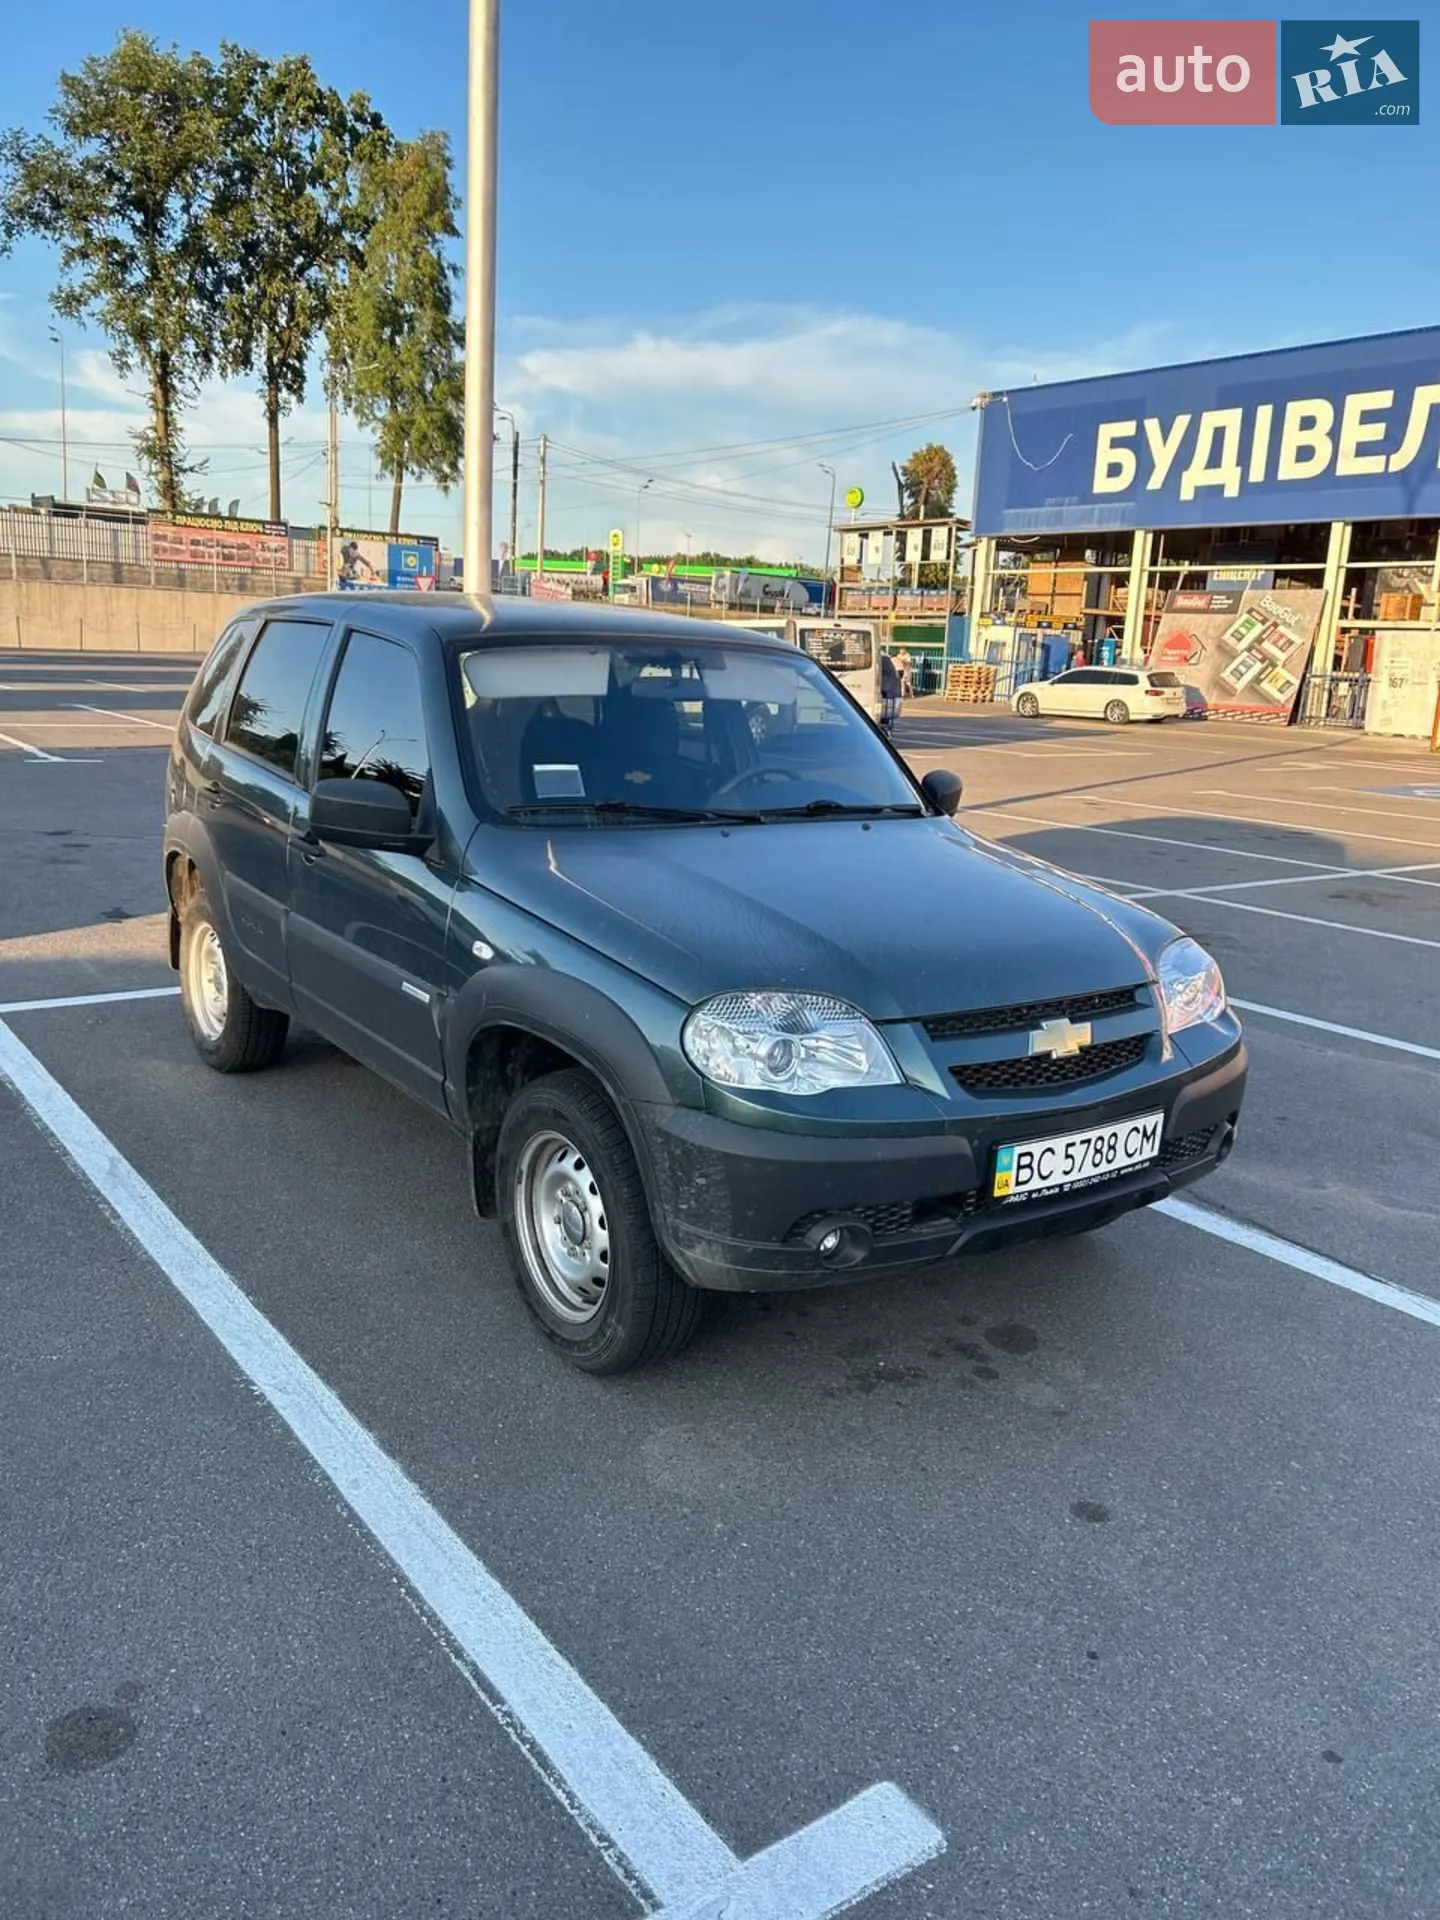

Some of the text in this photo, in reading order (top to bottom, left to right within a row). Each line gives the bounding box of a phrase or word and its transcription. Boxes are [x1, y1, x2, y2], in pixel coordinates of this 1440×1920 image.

[1092, 383, 1440, 501] БУДІВЕЛ
[997, 1177, 1009, 1190] UA
[1014, 1147, 1056, 1187] BC
[1062, 1131, 1118, 1176] 5788
[1124, 1120, 1159, 1159] CM
